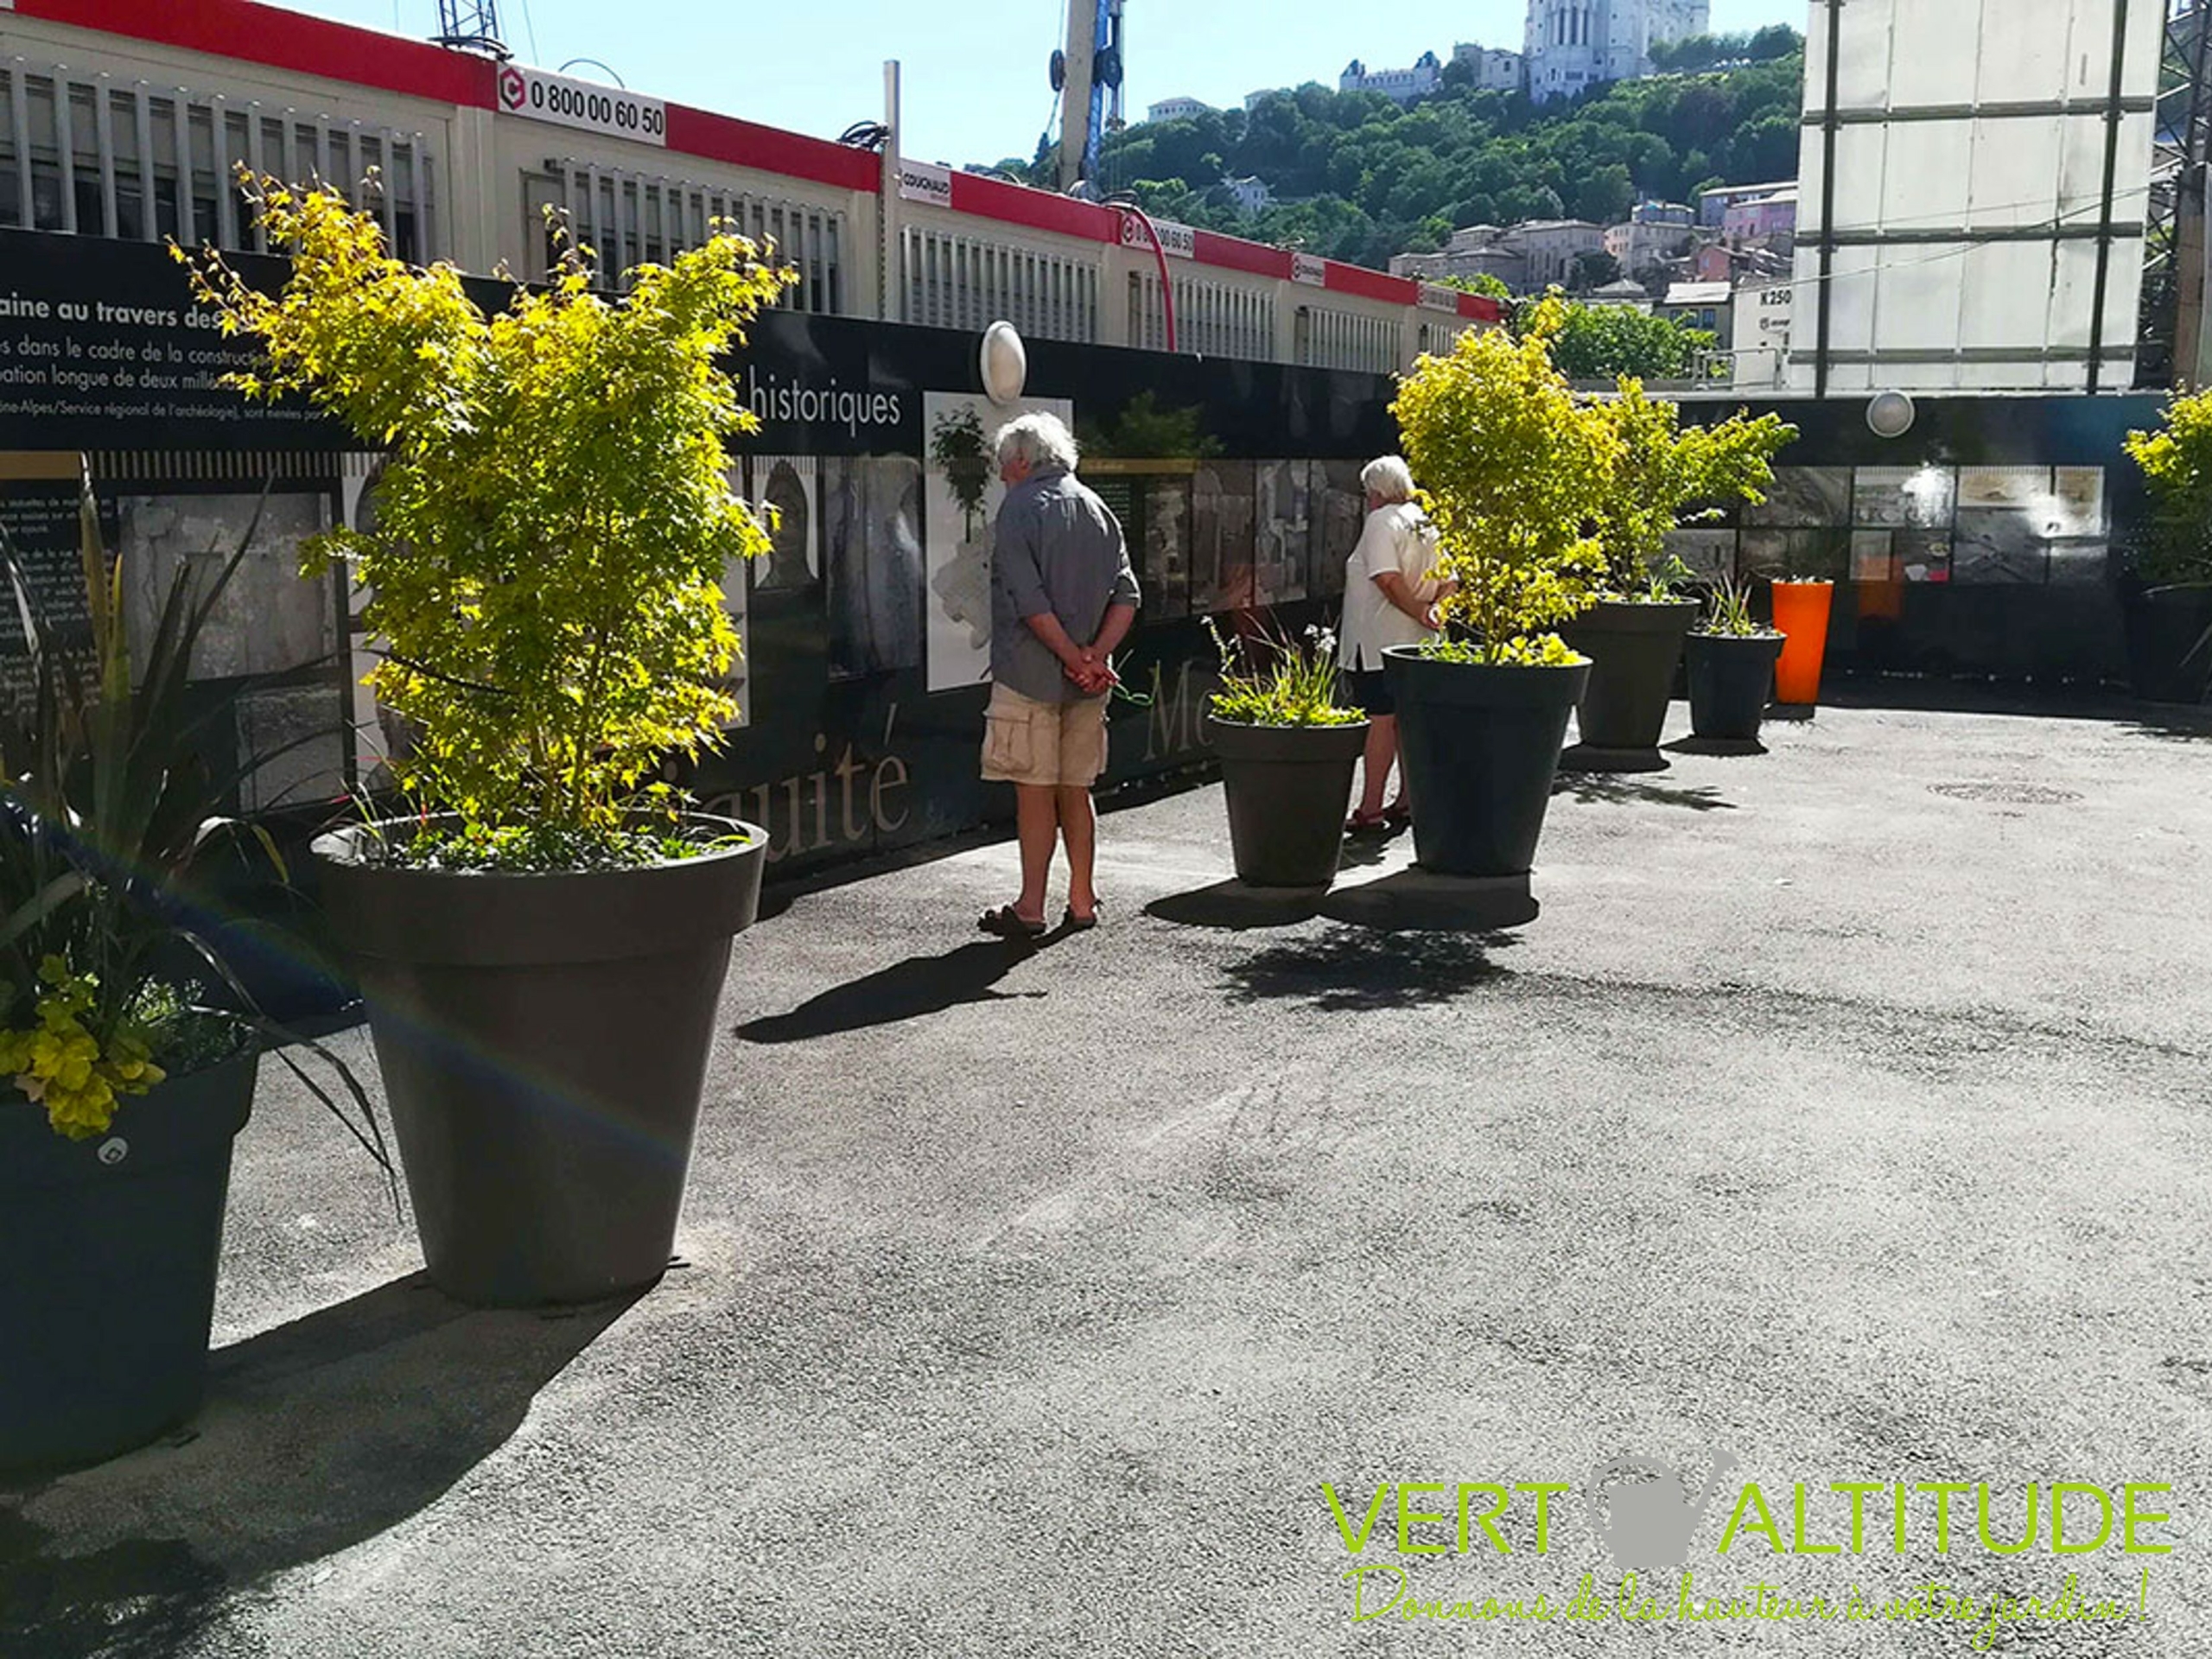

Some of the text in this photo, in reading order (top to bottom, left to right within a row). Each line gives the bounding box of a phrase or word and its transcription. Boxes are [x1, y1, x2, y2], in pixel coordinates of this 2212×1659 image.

[531, 81, 663, 136] 0 800 00 60 50
[57, 302, 89, 321] au
[96, 301, 177, 327] travers
[17, 334, 60, 357] dans
[66, 335, 82, 358] le
[88, 339, 136, 359] cadre
[141, 340, 162, 362] de
[168, 341, 183, 363] la
[0, 365, 47, 385] ation
[51, 363, 109, 391] longue
[113, 365, 135, 386] de
[139, 368, 178, 389] deux
[749, 364, 901, 438] historiques
